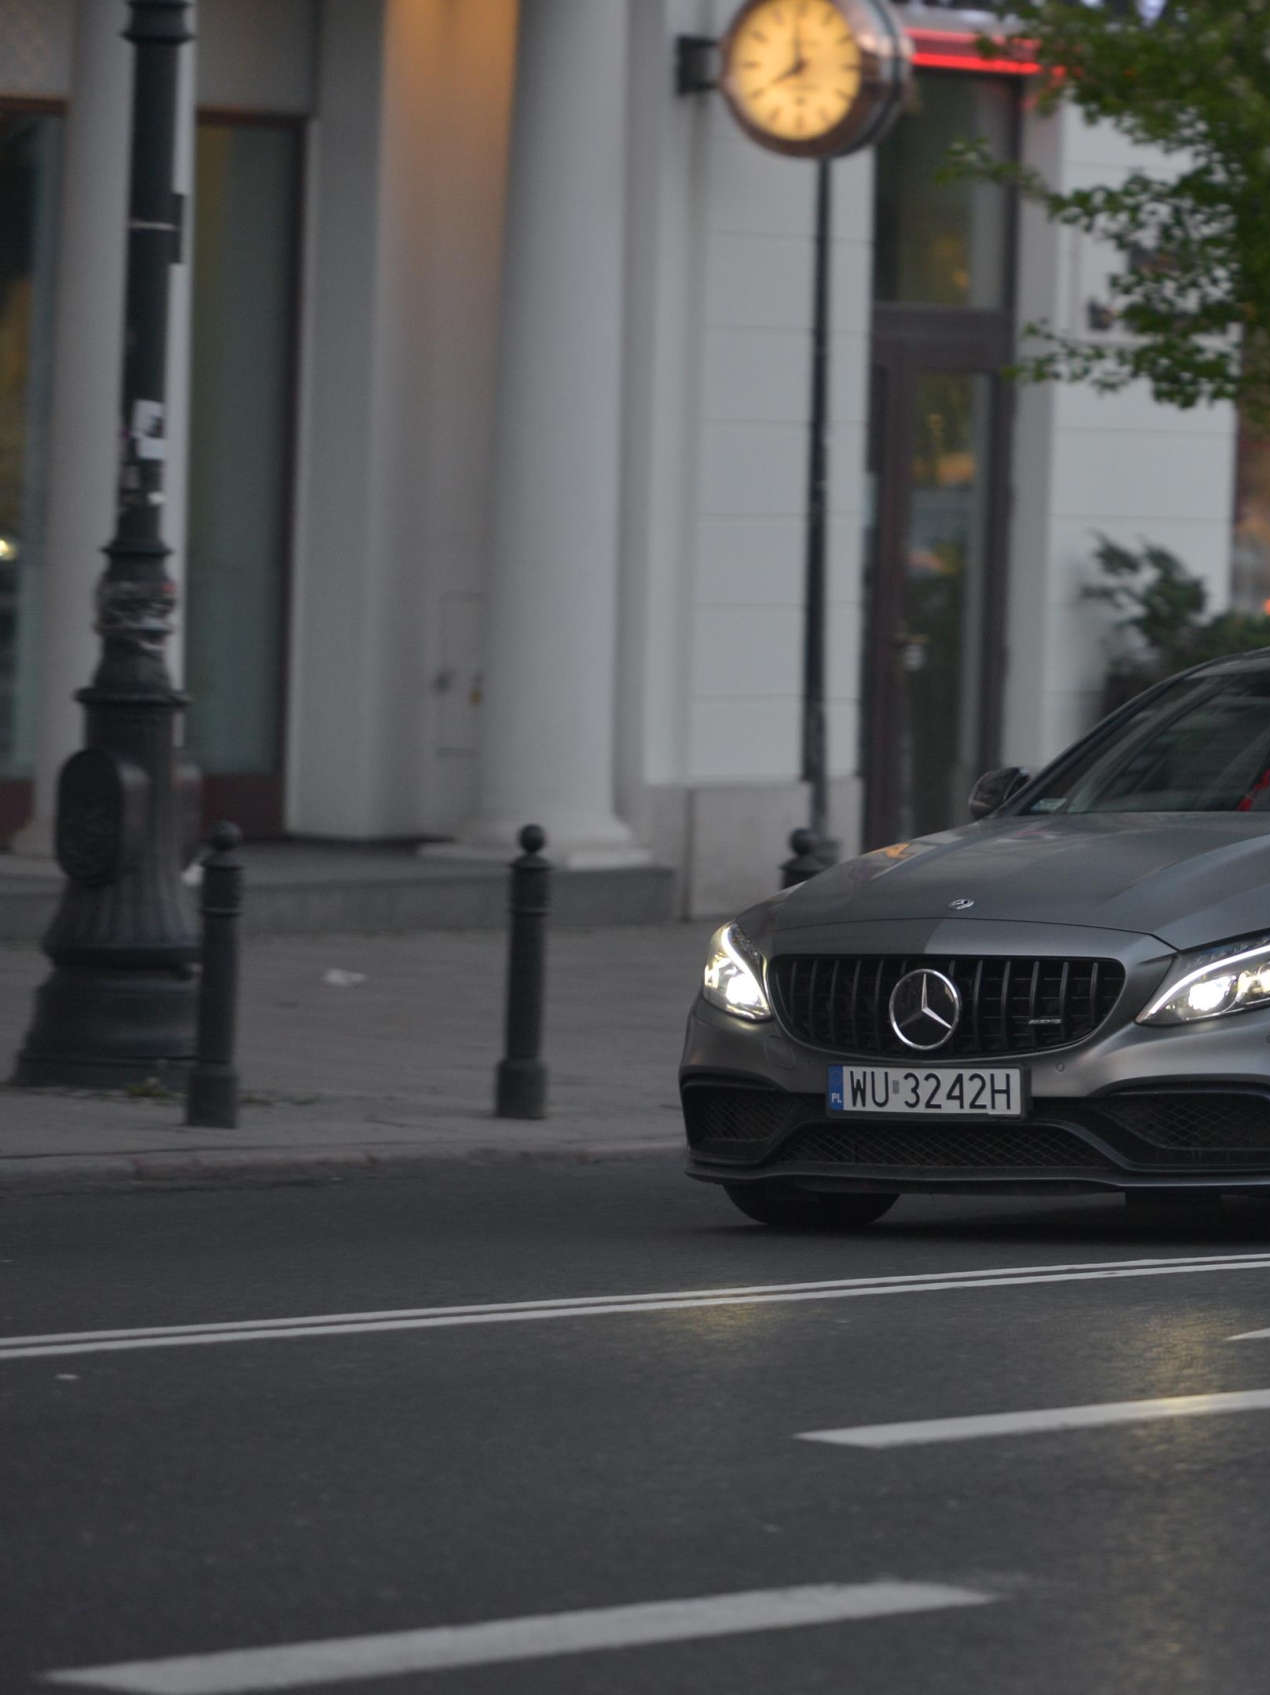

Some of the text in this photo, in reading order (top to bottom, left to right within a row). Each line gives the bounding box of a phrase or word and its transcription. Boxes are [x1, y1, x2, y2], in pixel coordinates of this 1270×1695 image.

[831, 1093, 842, 1104] PL
[850, 1070, 1012, 1110] WU 3242H
